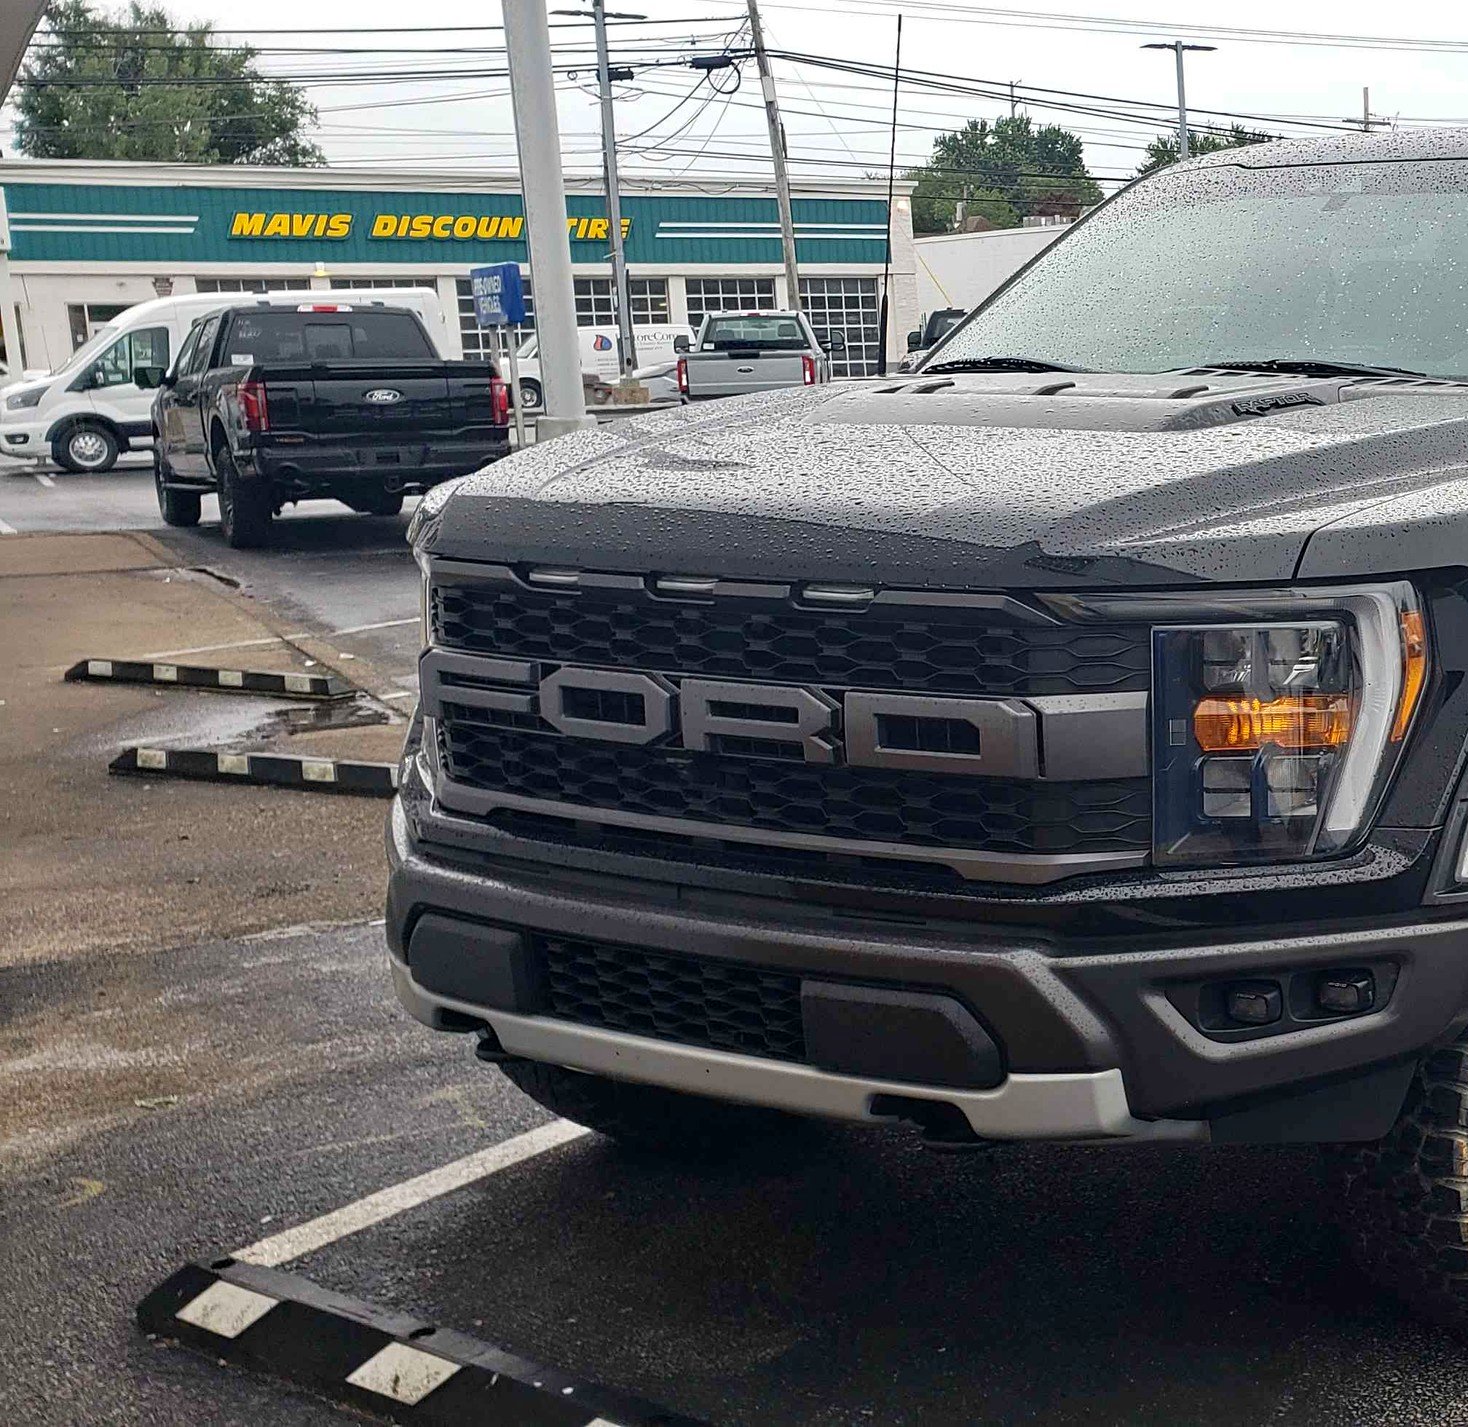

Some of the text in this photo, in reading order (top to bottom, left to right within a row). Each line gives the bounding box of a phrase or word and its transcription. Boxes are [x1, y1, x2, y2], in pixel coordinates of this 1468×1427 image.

[231, 212, 353, 238] MAVIS
[372, 214, 525, 239] DISCOUN
[1233, 392, 1313, 414] RAPTOR
[420, 647, 1041, 779] FORD
